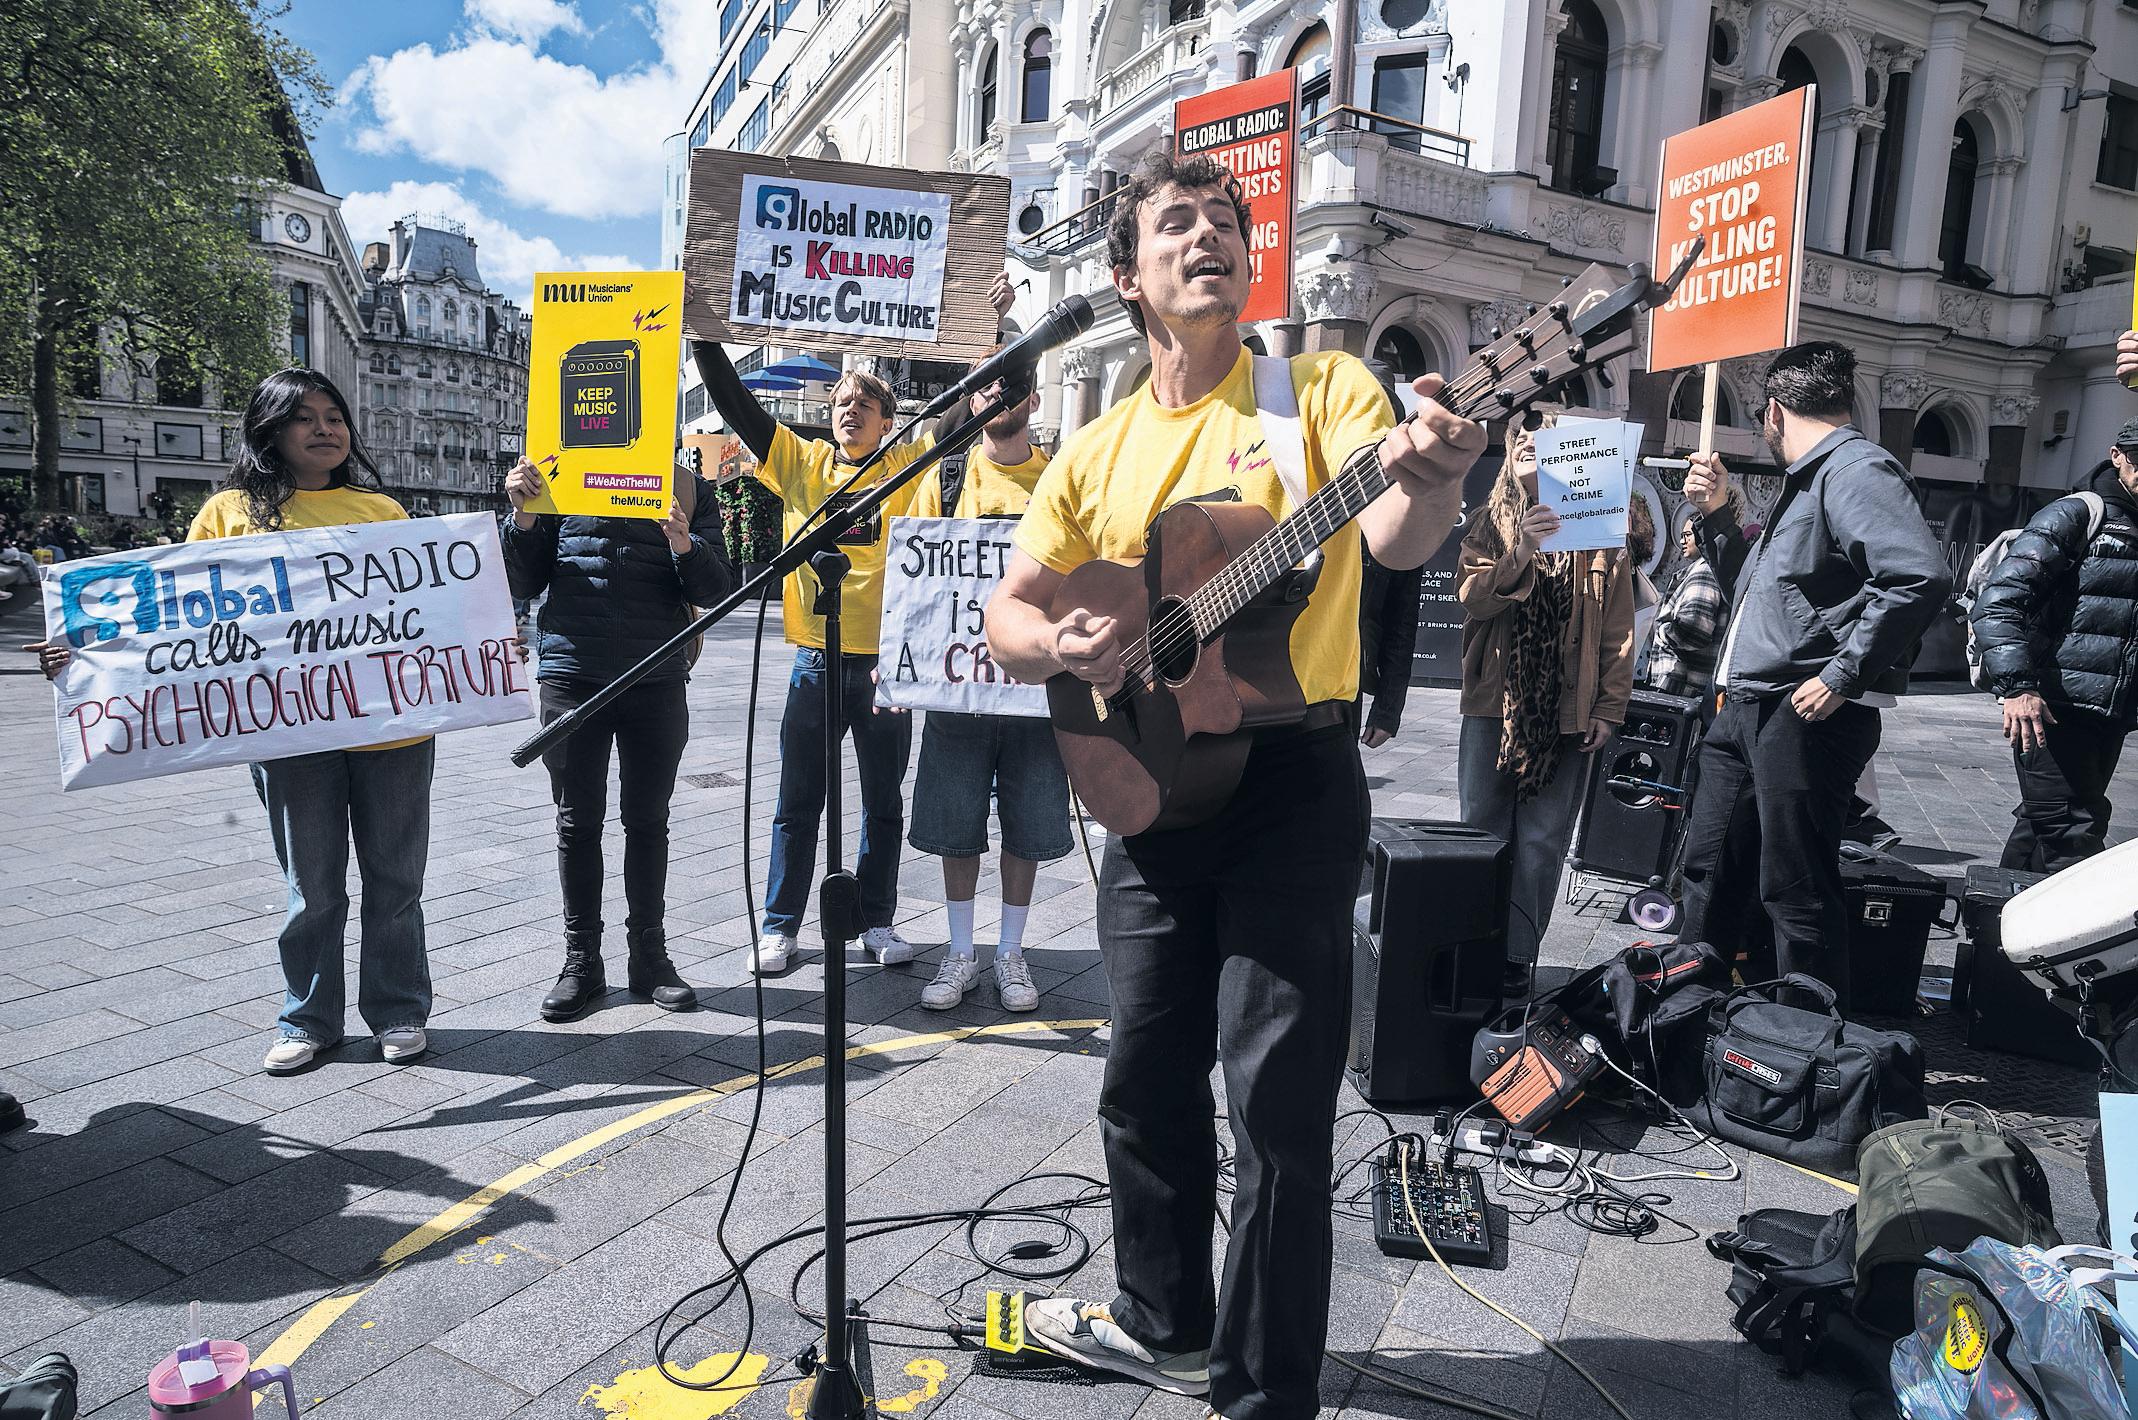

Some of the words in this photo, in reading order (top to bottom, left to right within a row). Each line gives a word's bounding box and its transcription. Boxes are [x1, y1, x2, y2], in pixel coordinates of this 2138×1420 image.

[1183, 120, 1233, 151] GLOBAL
[1236, 107, 1284, 140] RADIO:
[1668, 141, 1791, 199] WESTMINSTER,
[1236, 168, 1282, 200] TISTS
[1687, 181, 1760, 232] STOP
[865, 210, 932, 240] RADIO
[772, 245, 793, 268] IS
[588, 283, 634, 293] Musicians'
[588, 293, 613, 302] Union
[577, 387, 614, 401] KEEP
[573, 402, 618, 416] MUSIC
[580, 417, 610, 430] LIVE
[1559, 437, 1597, 450] STREET
[1541, 447, 1619, 466] PERFORMANCE
[1574, 466, 1584, 474] IS
[586, 476, 661, 489] #WeAreTheMU
[1569, 478, 1591, 488] NOT
[611, 495, 662, 509] theMU.org
[1561, 494, 1569, 503] A
[1570, 490, 1604, 501] CRIME
[1557, 507, 1625, 521] ncelglobalradio
[901, 535, 1011, 579] STREET
[315, 540, 482, 603] RADIO
[1434, 571, 1452, 579] AND
[145, 621, 267, 675] calls
[286, 600, 425, 655] music
[896, 642, 919, 683] A
[367, 637, 530, 716] TORTURE
